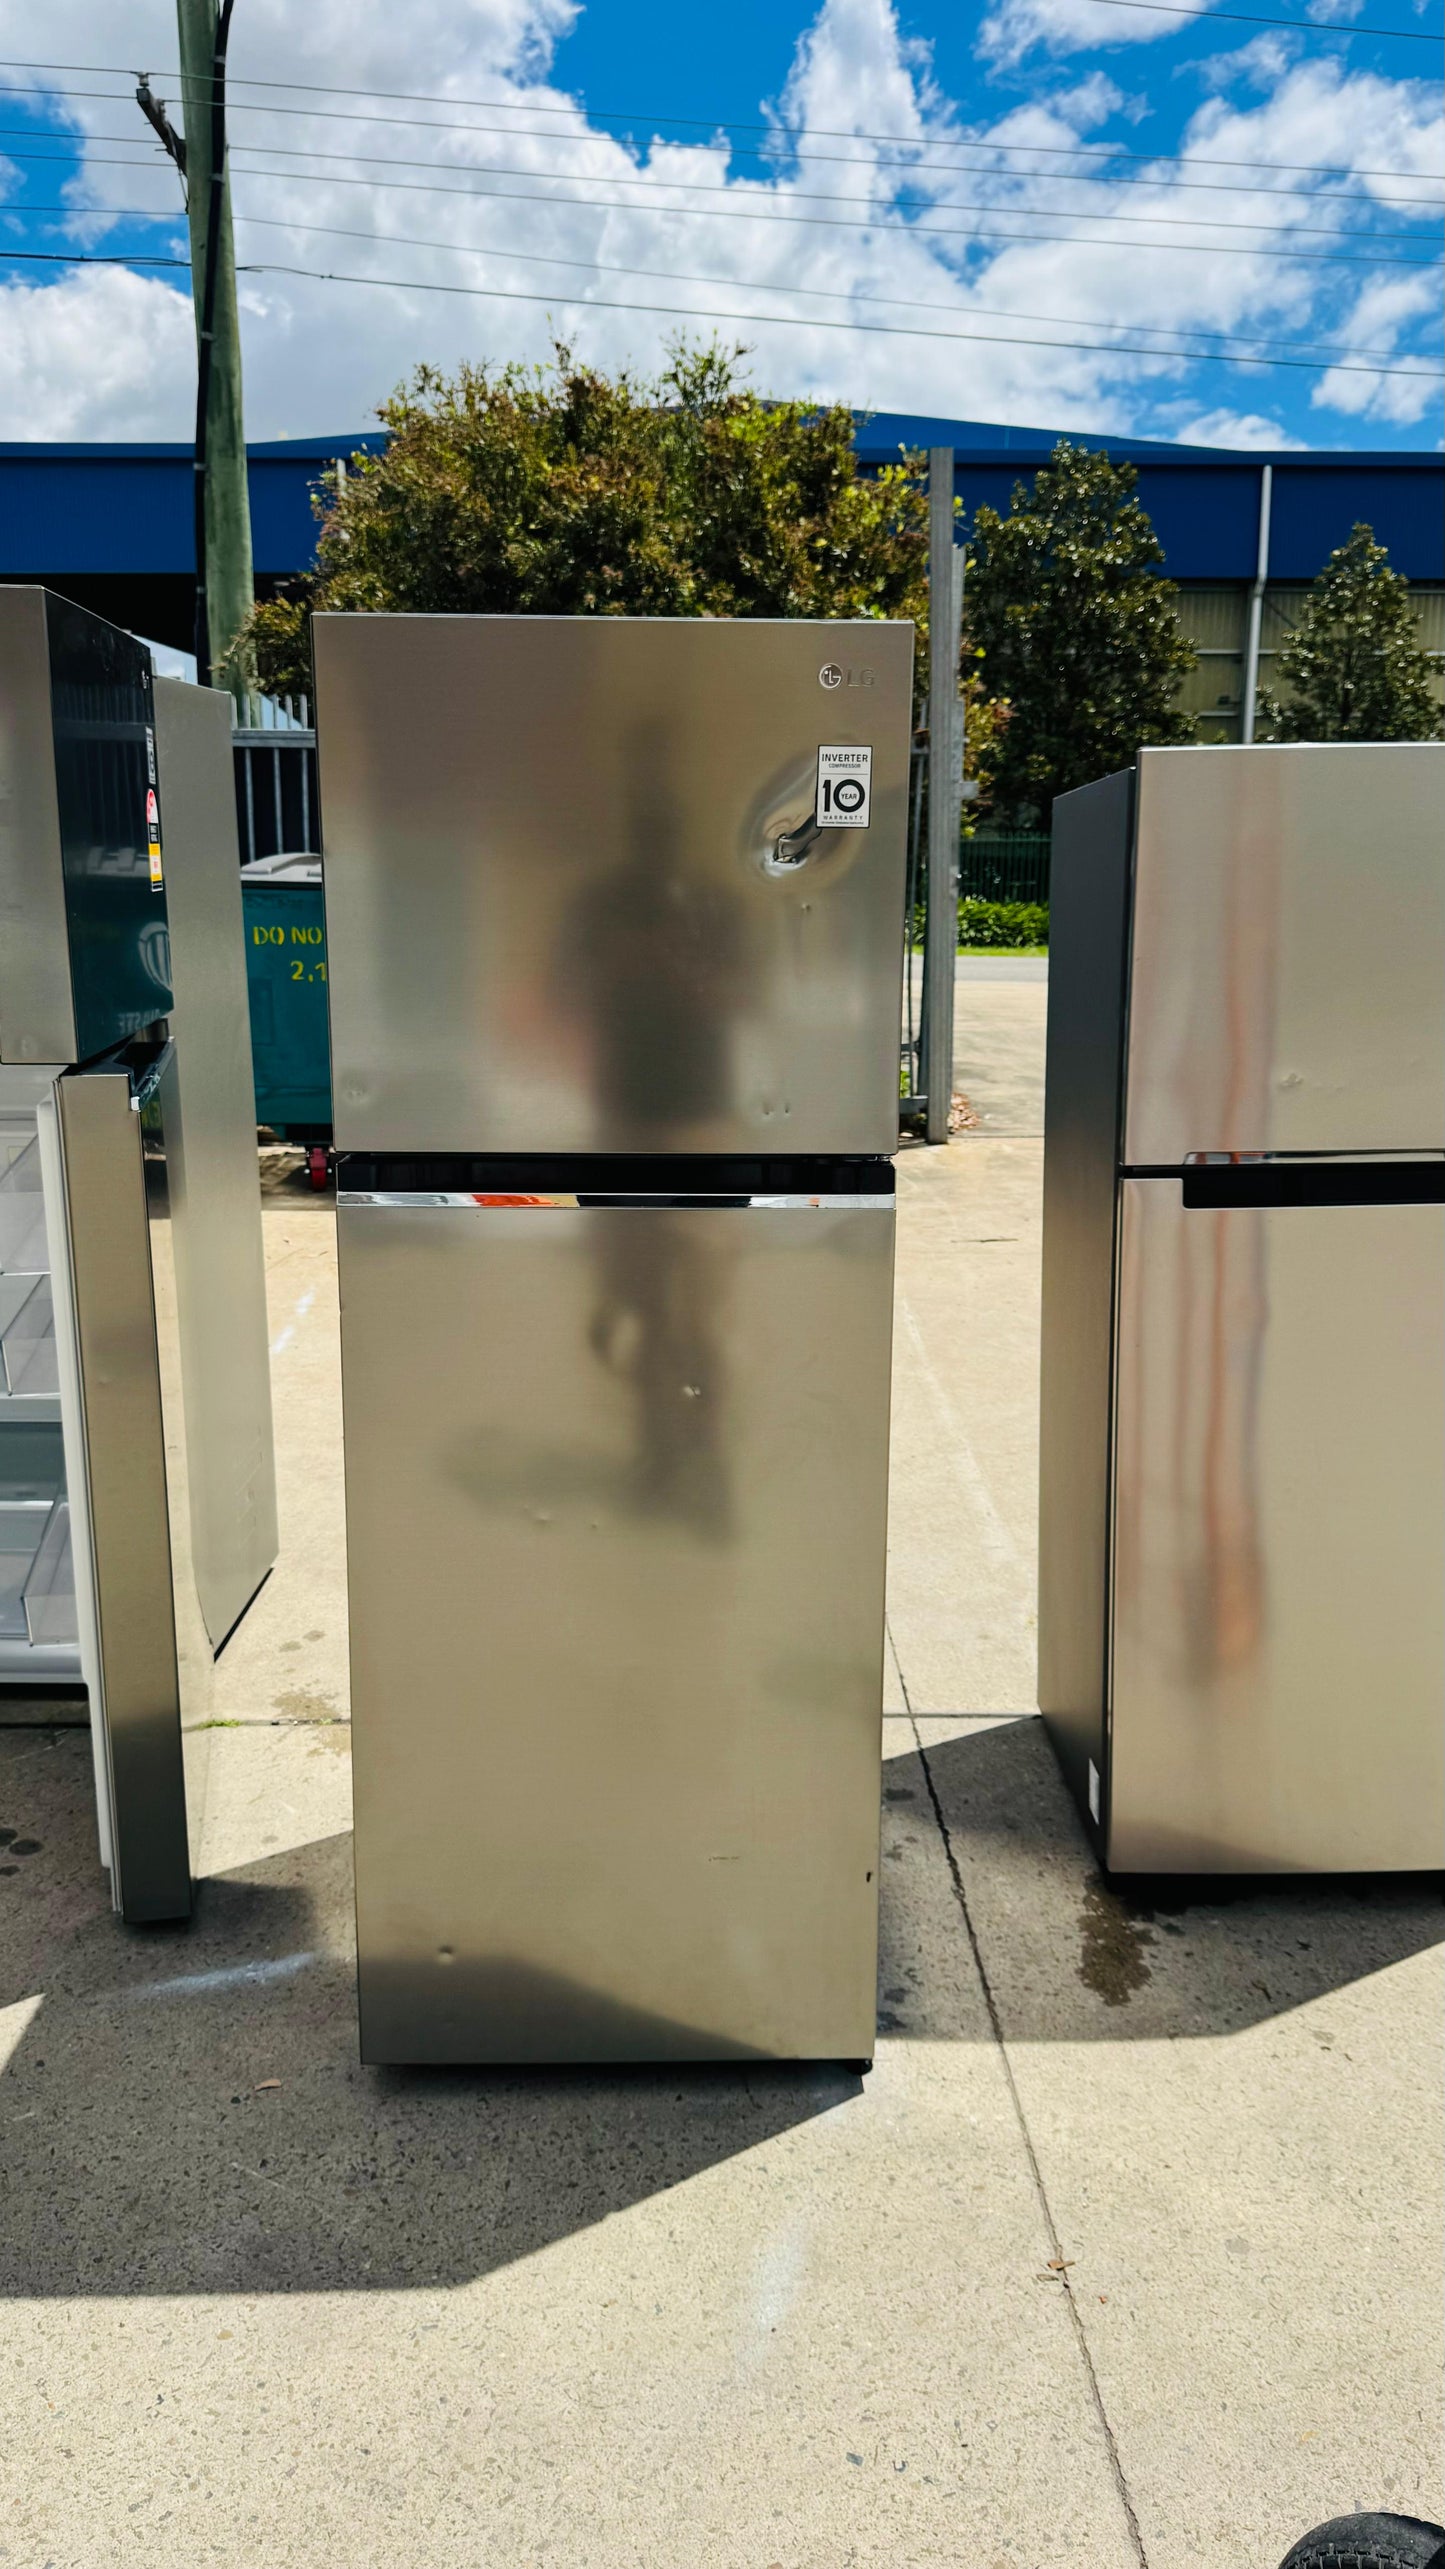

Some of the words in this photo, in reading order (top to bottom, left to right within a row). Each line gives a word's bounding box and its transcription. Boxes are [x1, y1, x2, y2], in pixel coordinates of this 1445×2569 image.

[847, 668, 874, 688] LG
[821, 753, 869, 763] INVERTER
[822, 778, 866, 813] 10
[253, 926, 285, 945] DO
[291, 926, 323, 945] NO
